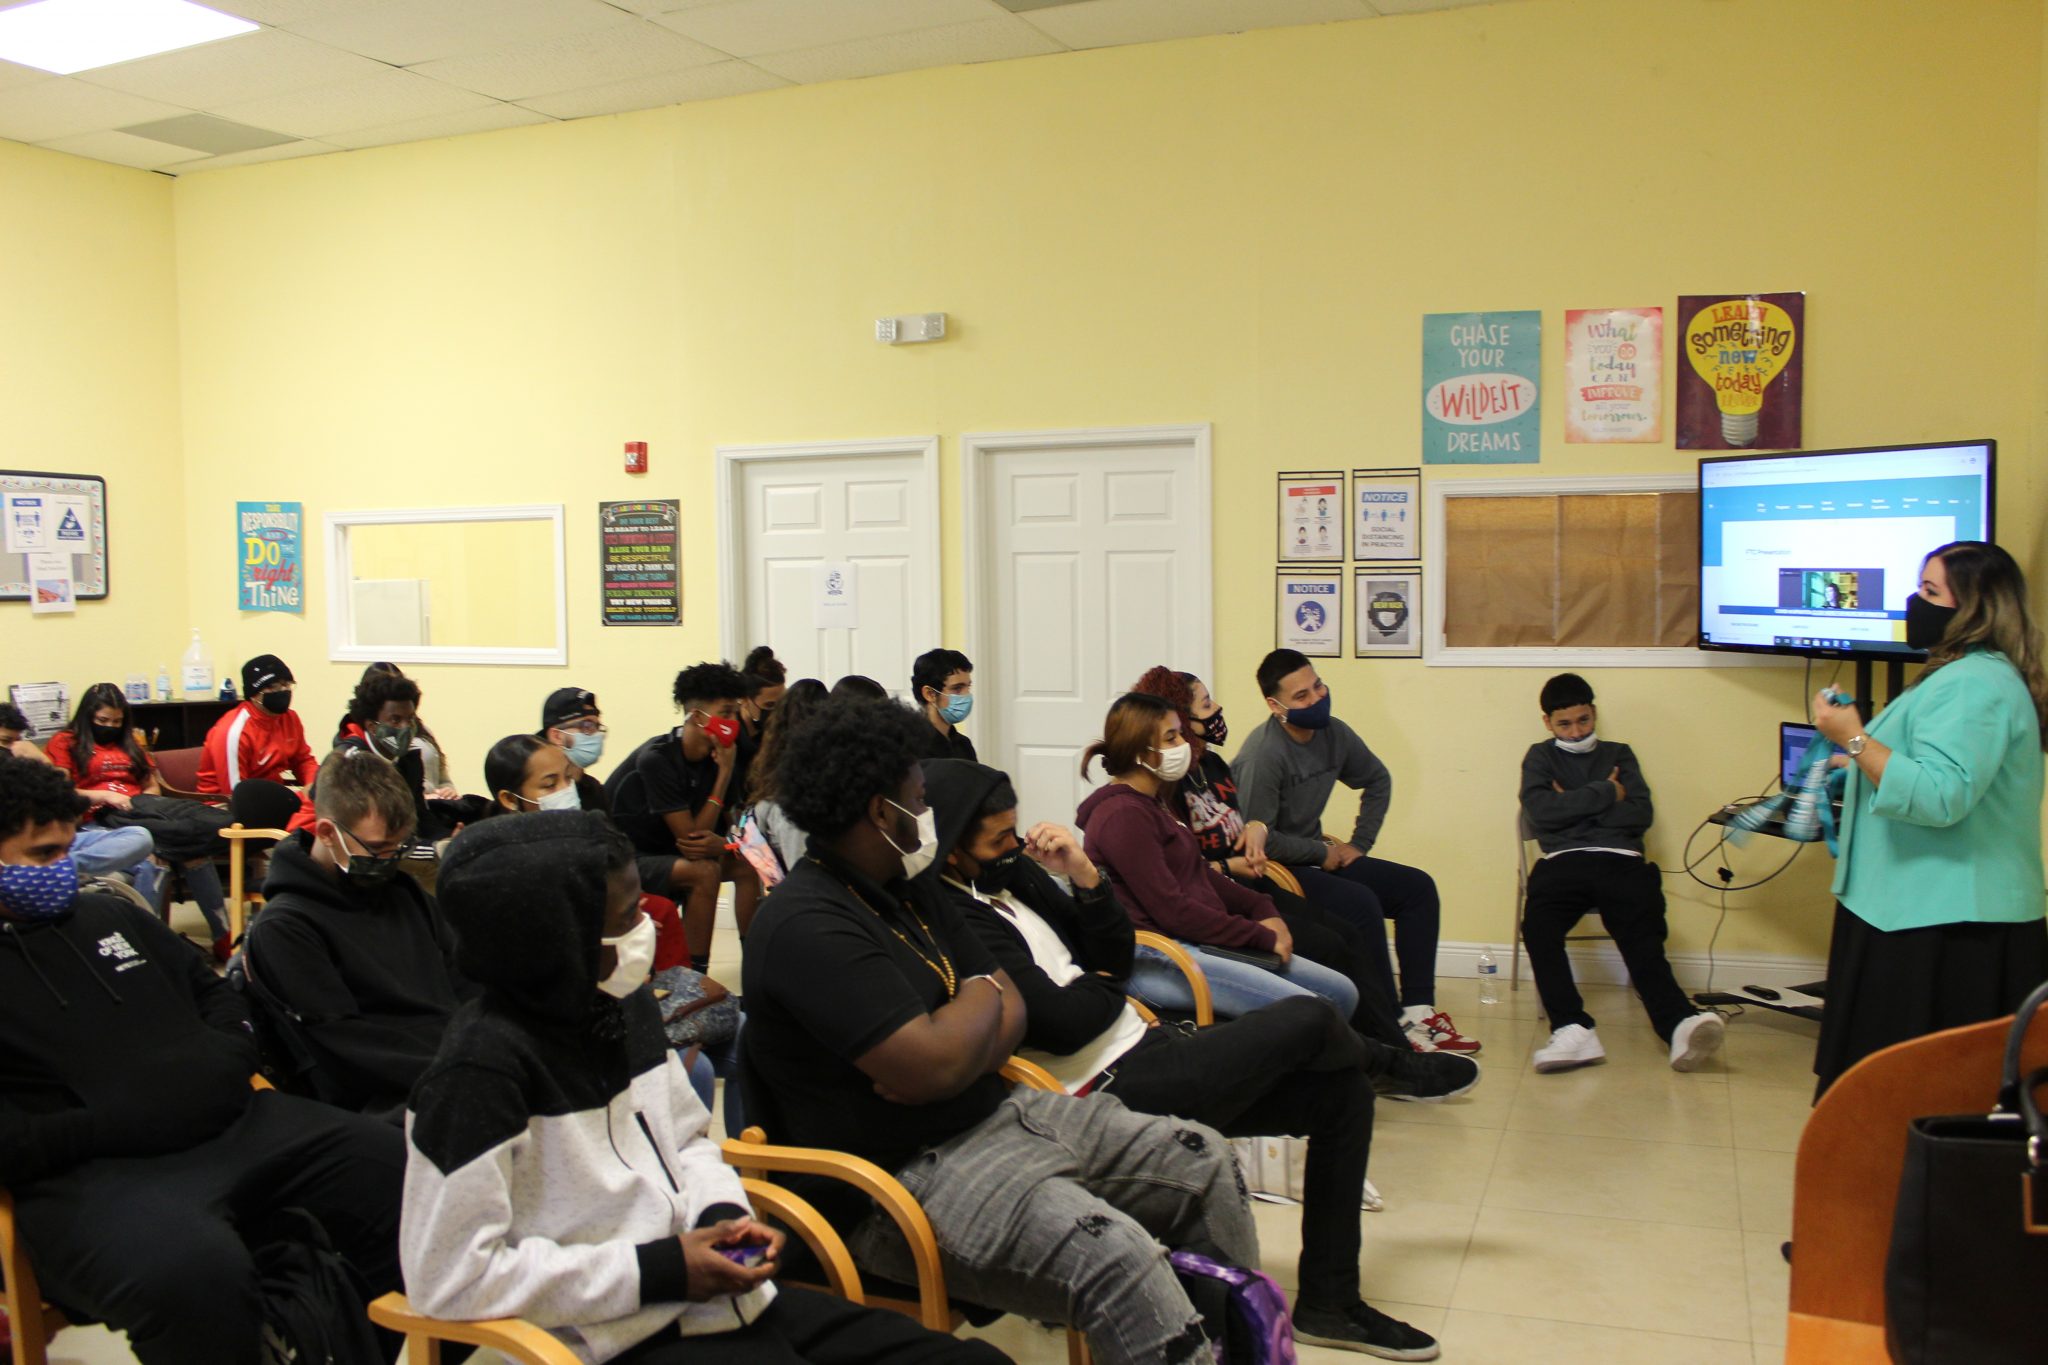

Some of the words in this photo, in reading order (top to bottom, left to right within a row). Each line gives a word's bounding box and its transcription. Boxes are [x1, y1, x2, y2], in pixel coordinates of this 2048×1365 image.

[1451, 324, 1510, 346] CHASE
[1588, 318, 1638, 341] What
[1458, 348, 1505, 368] YOUR
[1589, 355, 1636, 379] today
[1718, 350, 1758, 365] new
[1591, 374, 1629, 382] CAN
[1715, 372, 1761, 395] today
[1447, 432, 1521, 453] DREAMS
[1364, 493, 1406, 502] NOTICE
[244, 537, 281, 565] DO
[252, 558, 294, 590] right
[1293, 584, 1329, 593] NOTICE
